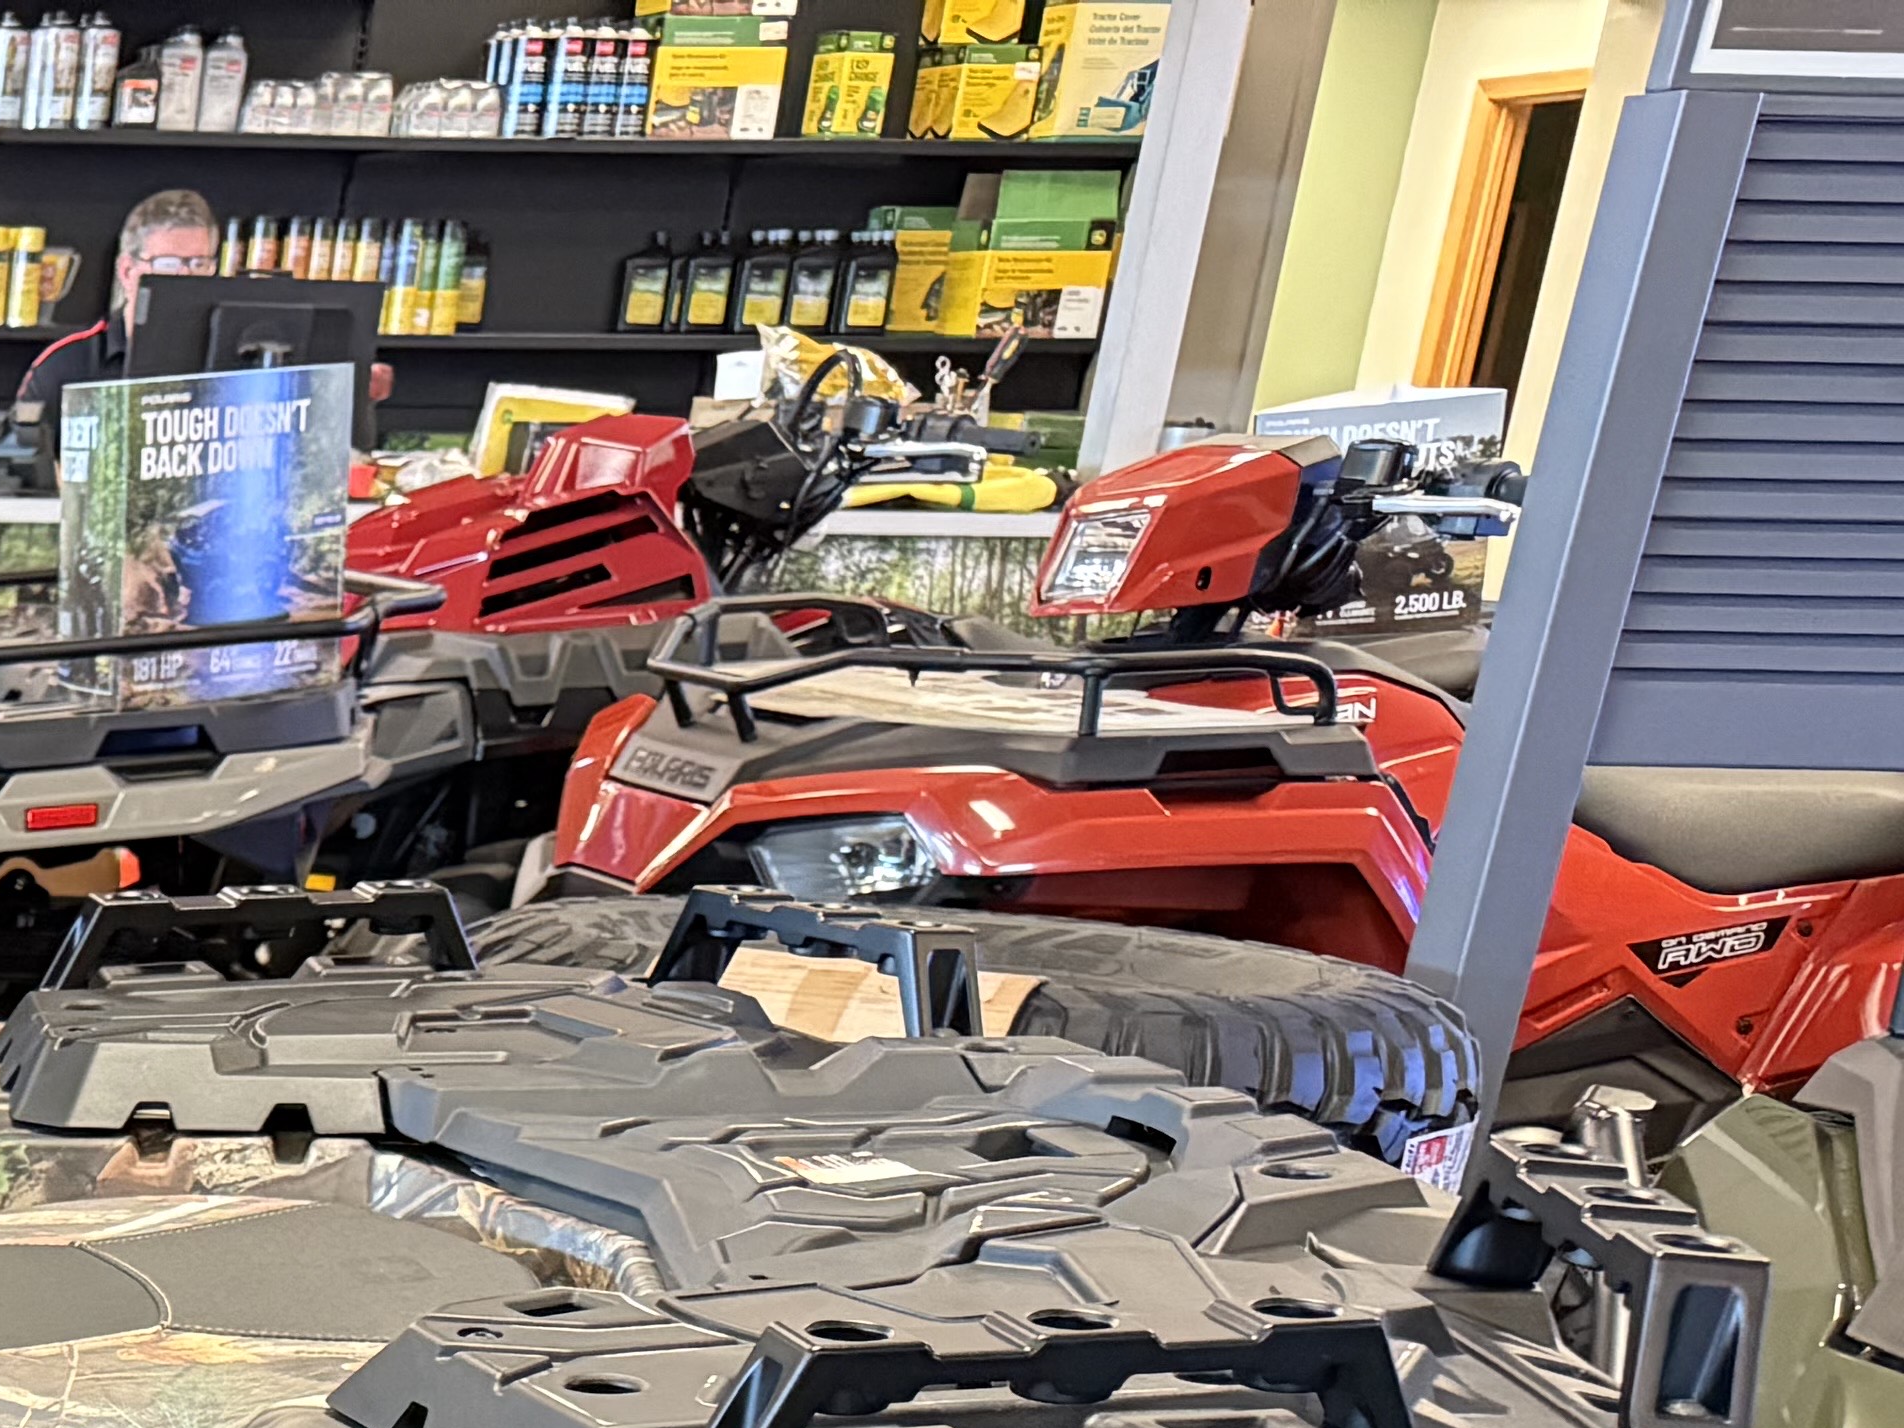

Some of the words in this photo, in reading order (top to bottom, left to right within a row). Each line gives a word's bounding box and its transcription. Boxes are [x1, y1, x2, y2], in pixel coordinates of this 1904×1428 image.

[141, 406, 219, 445] TOUGH
[224, 399, 311, 438] DOESN'T
[141, 444, 204, 480] BACK
[208, 436, 274, 475] DOWN
[1441, 591, 1467, 612] LB.
[160, 653, 183, 680] HP
[1692, 921, 1768, 942] DEMAND
[1657, 931, 1765, 970] AWD
